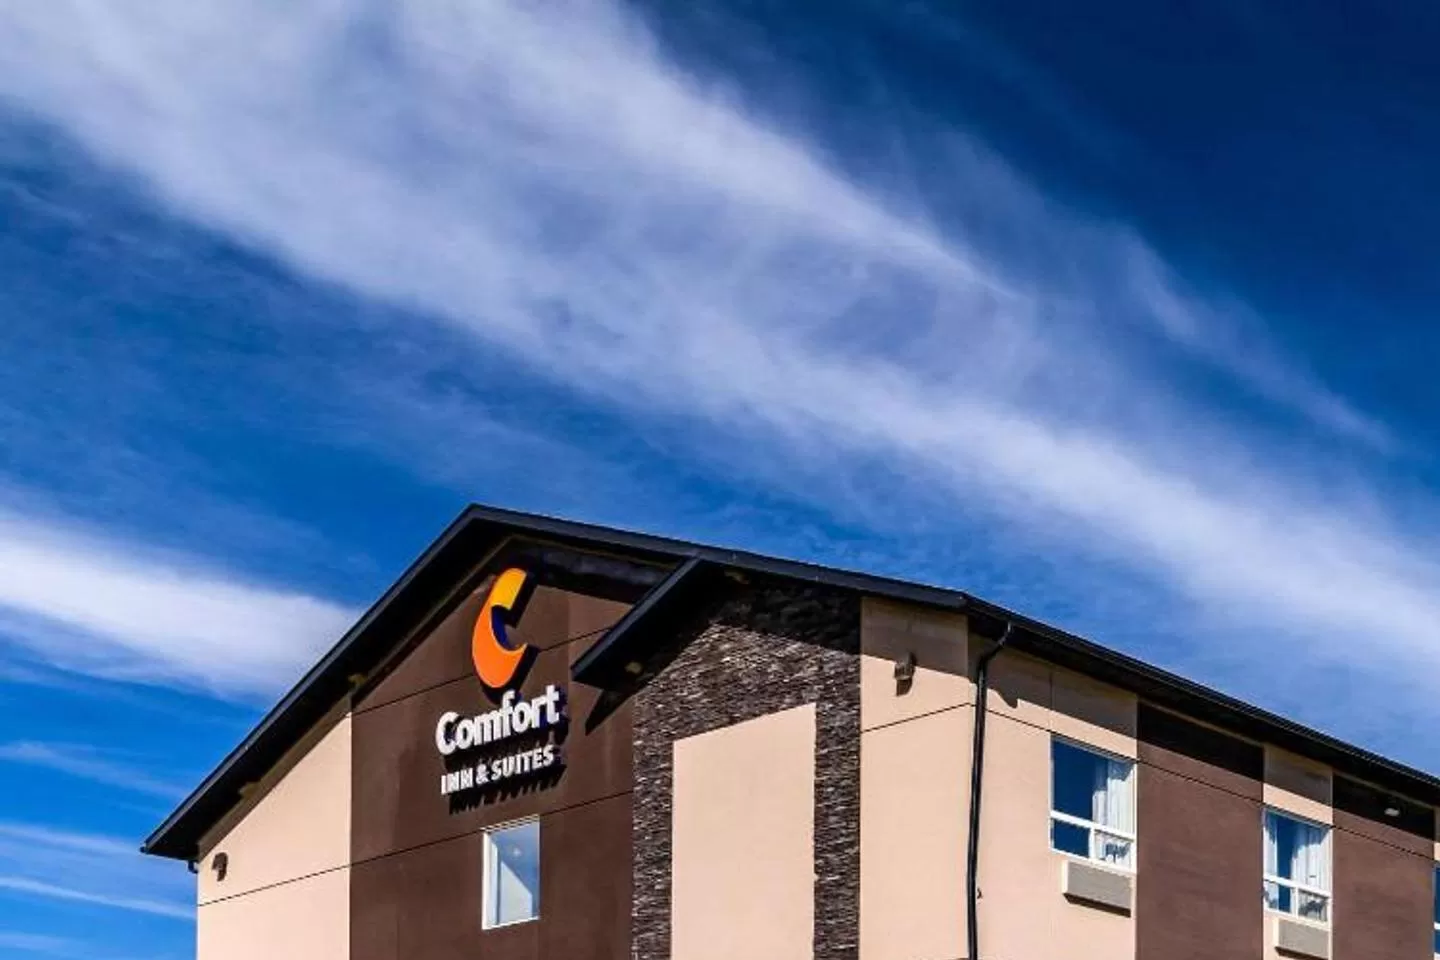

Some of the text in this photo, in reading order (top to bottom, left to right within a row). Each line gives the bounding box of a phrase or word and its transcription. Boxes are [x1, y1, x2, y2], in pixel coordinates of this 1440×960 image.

[435, 684, 560, 755] Comfort
[441, 744, 554, 795] INN & SUITES
